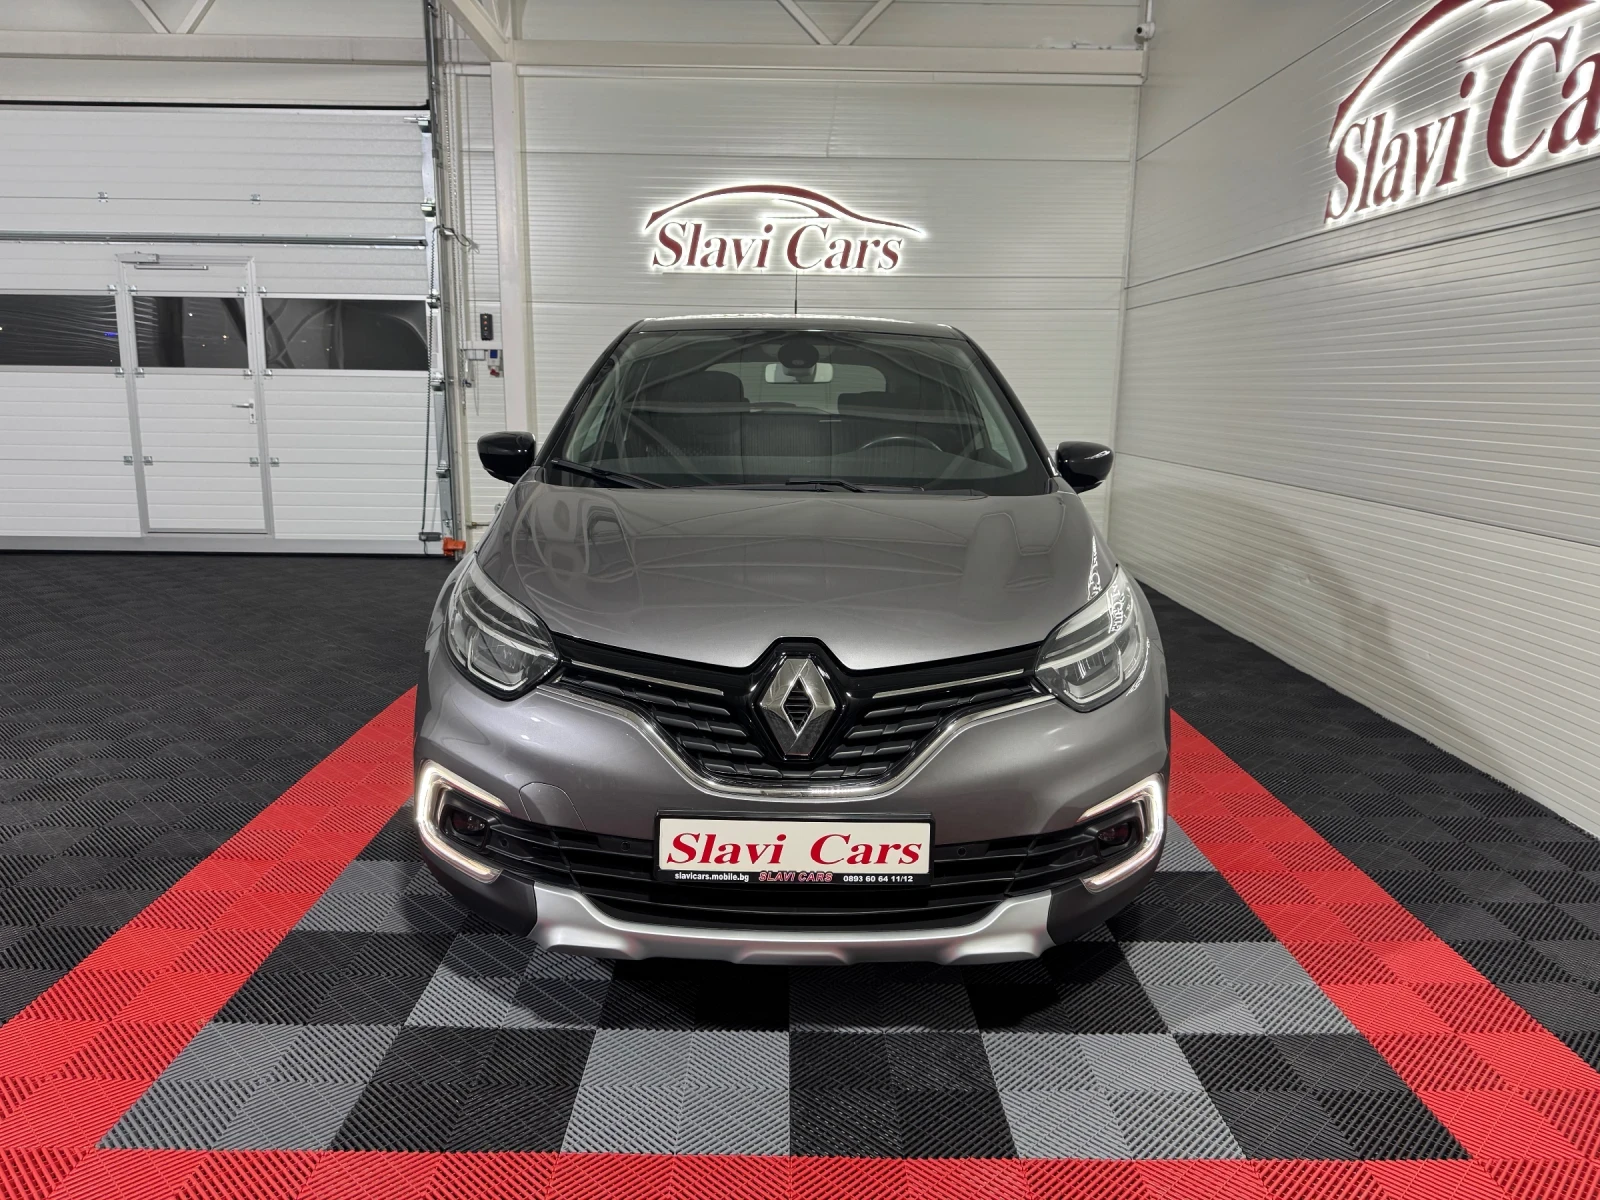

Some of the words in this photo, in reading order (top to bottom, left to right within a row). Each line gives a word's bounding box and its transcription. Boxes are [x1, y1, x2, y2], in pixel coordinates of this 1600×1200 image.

[1324, 71, 1475, 224] Slavi
[652, 221, 774, 268] Slavi
[786, 223, 903, 270] Cars
[666, 832, 787, 865] Slavi
[810, 833, 923, 865] Cars
[675, 873, 749, 882] slavicars.mobile.bg
[758, 871, 796, 882] SLAVI
[798, 872, 833, 882] CARS
